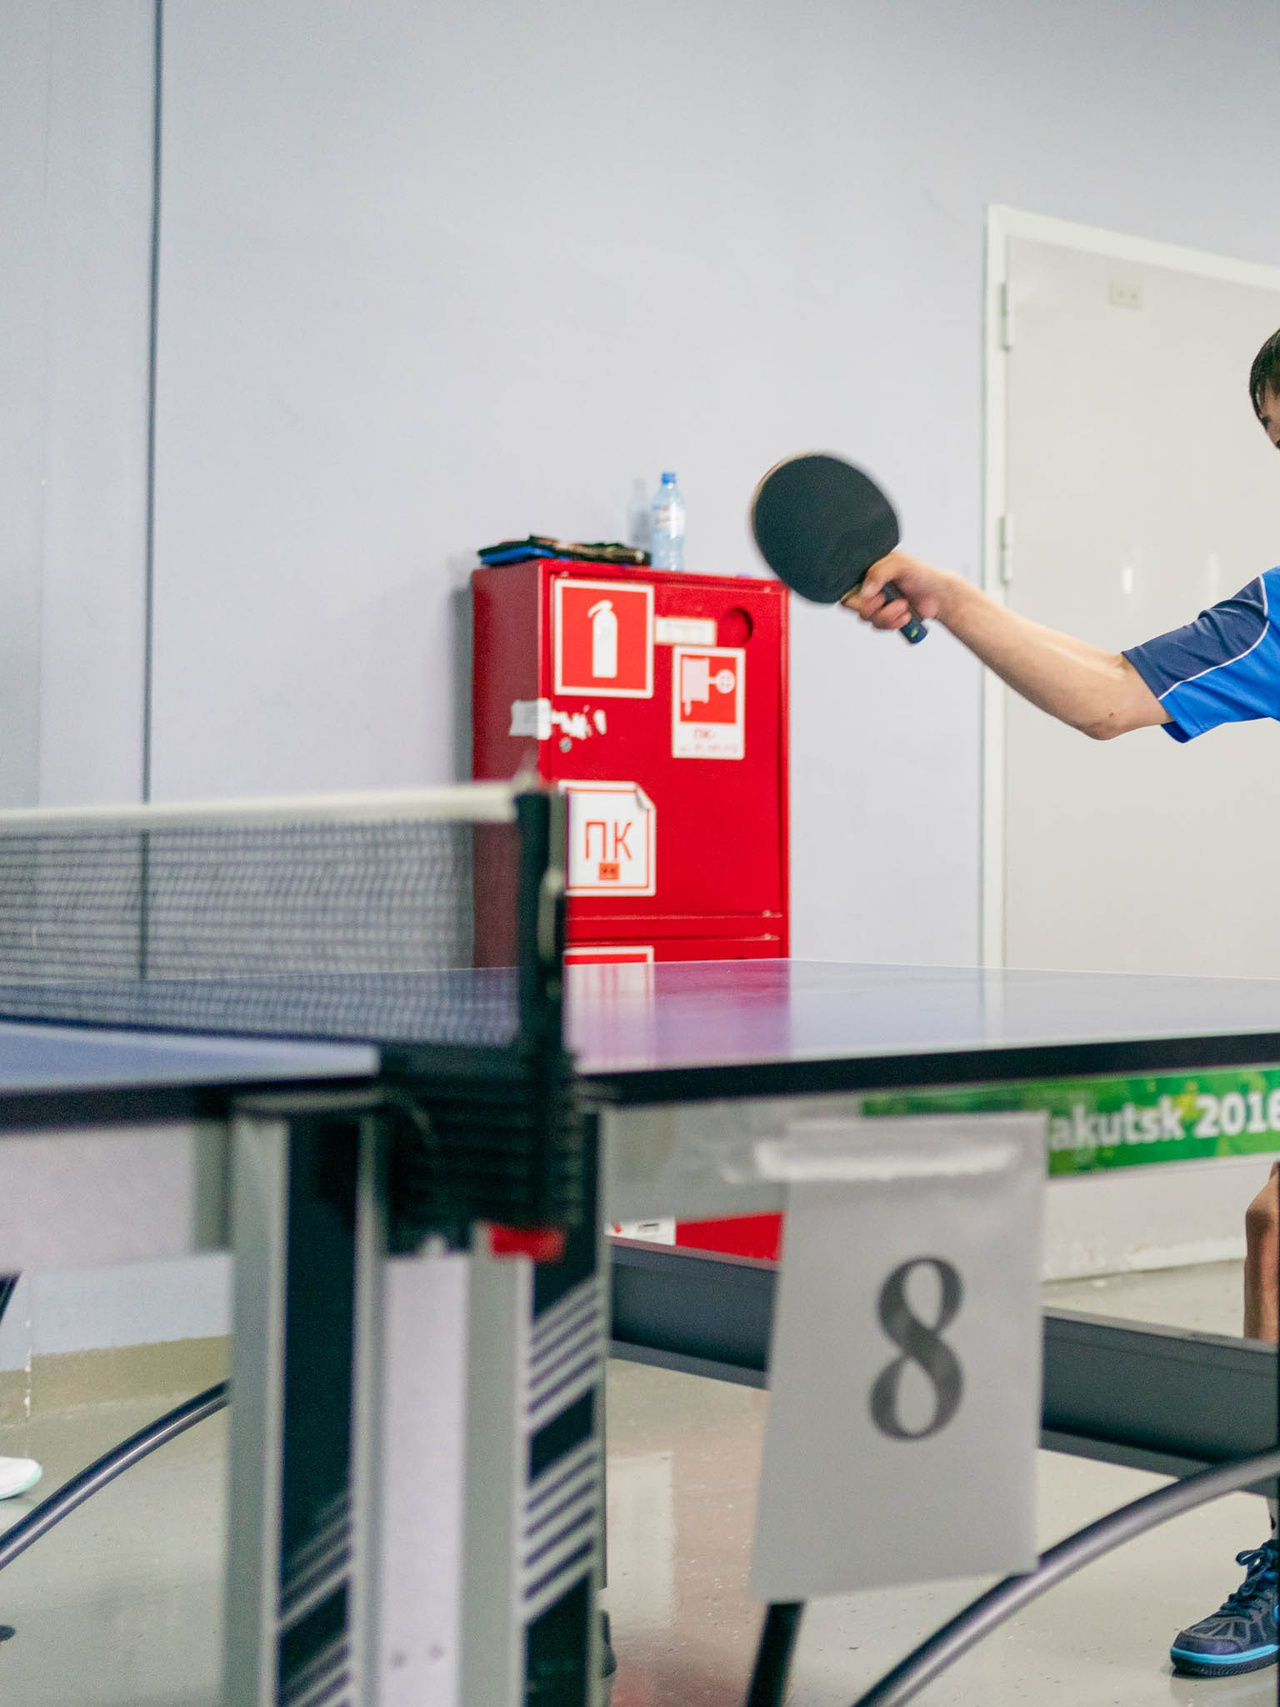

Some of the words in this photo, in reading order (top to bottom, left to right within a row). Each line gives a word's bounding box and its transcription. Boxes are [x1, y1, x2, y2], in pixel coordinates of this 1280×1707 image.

[584, 820, 633, 861] ПК
[1048, 1094, 1185, 1150] akutsk
[869, 1255, 964, 1442] 8
